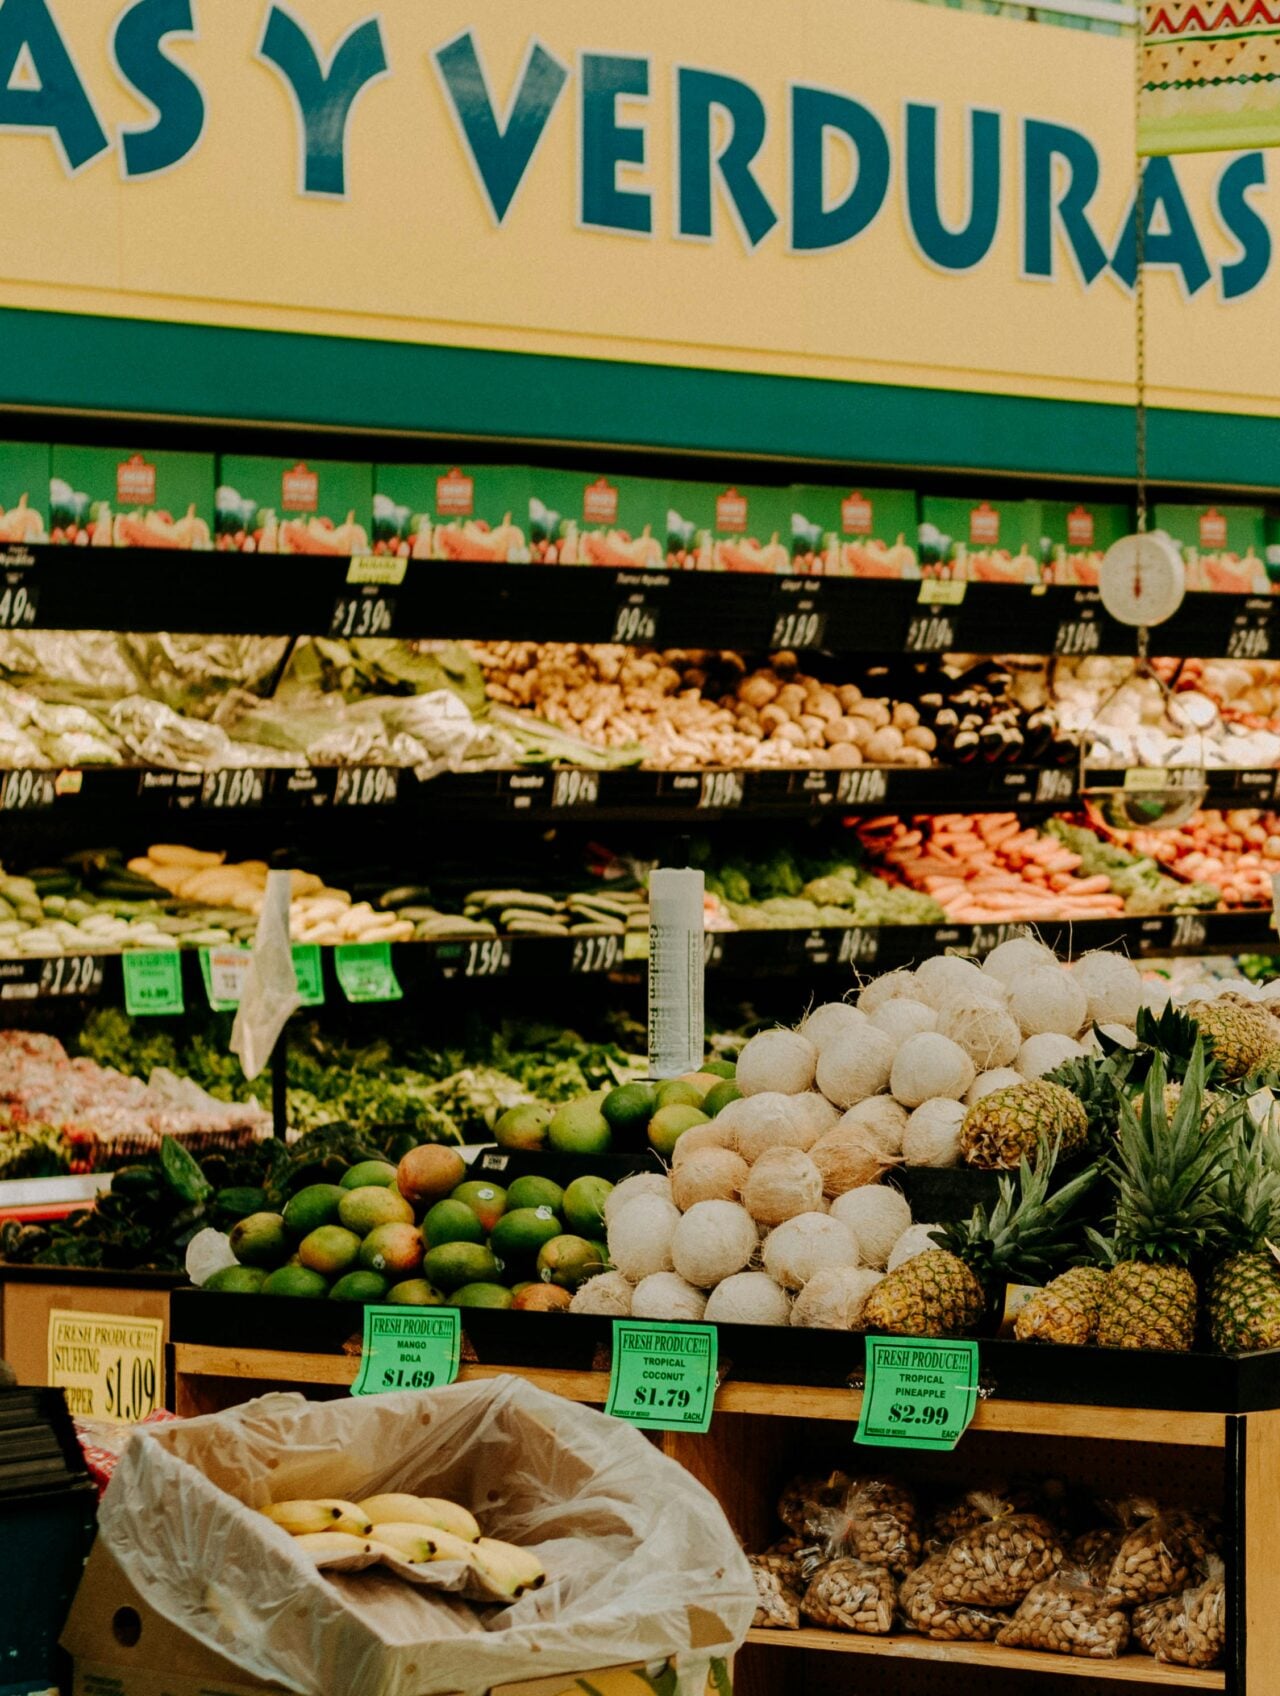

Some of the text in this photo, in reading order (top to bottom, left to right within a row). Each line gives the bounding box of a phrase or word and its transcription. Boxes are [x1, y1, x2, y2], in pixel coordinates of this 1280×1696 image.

[0, 0, 1272, 299] AS Y VERDURAS
[57, 1324, 92, 1342] FRESH
[373, 1318, 401, 1334] FRESH
[397, 1341, 427, 1349] MANGO
[622, 1333, 652, 1350] FRESH
[643, 1357, 686, 1368] TROPICAL
[877, 1349, 969, 1371] FRESH PRODUCE!!!
[382, 1368, 435, 1388] $1.69
[642, 1371, 685, 1381] COCONUT
[900, 1374, 944, 1384] TROPICAL
[105, 1356, 155, 1420] $1.09
[895, 1388, 946, 1398] PINEAPPLE
[633, 1386, 690, 1408] $1.79
[888, 1403, 949, 1425] $2.99
[942, 1430, 959, 1438] EACH
